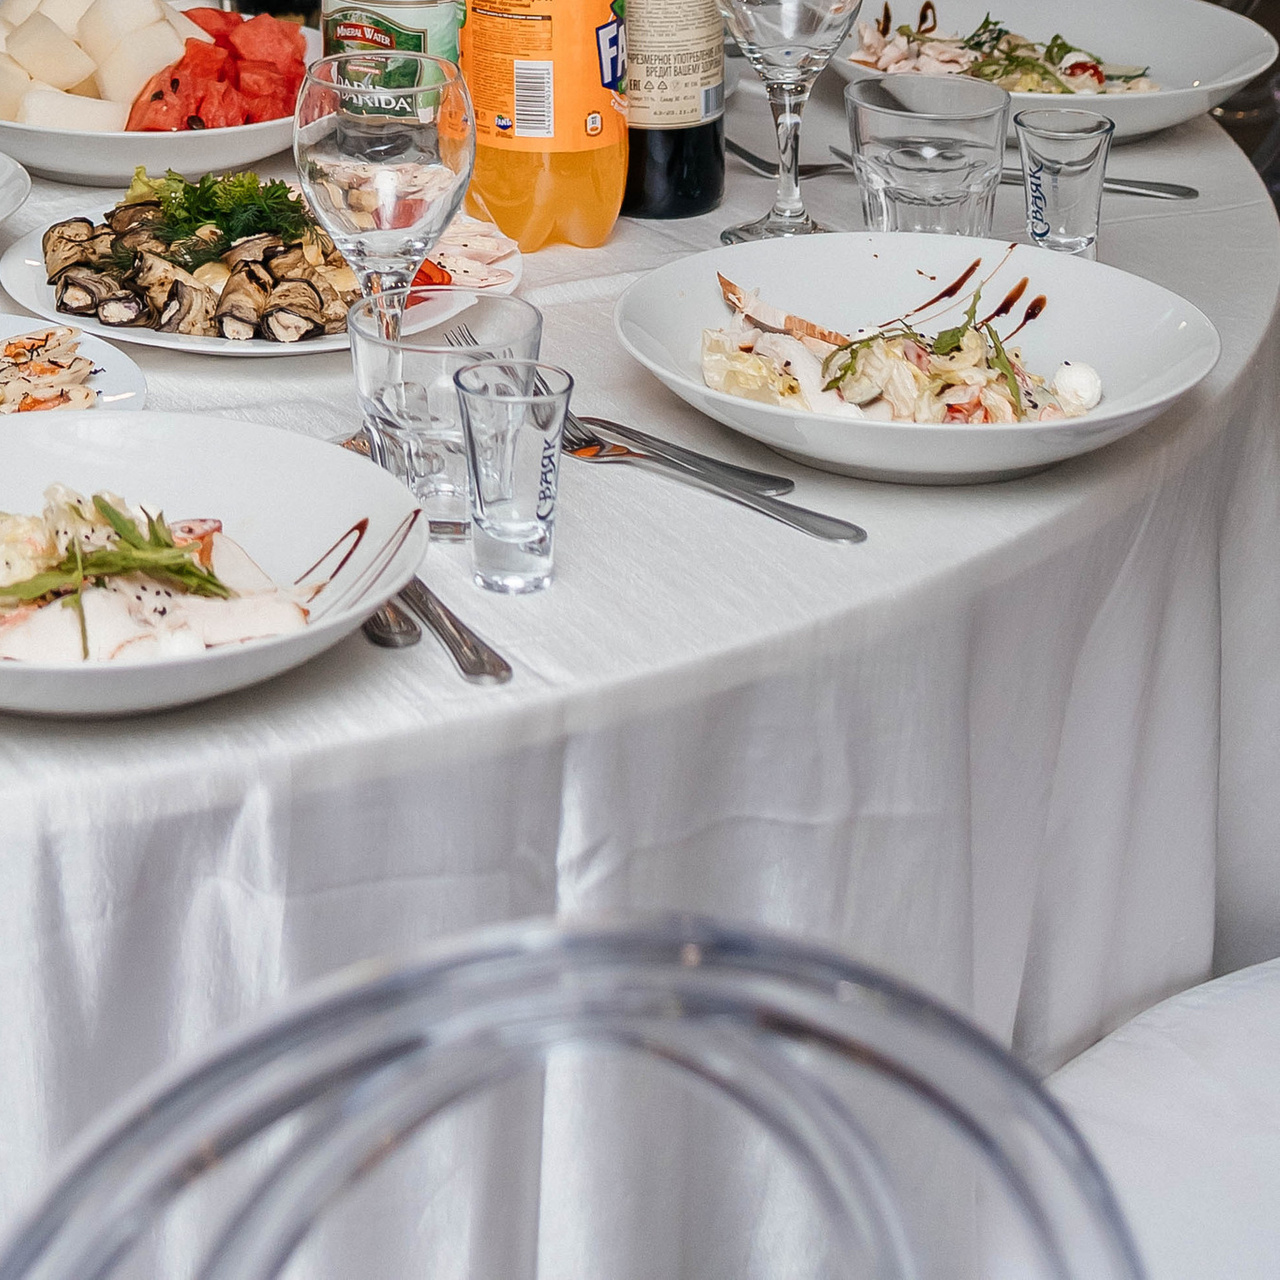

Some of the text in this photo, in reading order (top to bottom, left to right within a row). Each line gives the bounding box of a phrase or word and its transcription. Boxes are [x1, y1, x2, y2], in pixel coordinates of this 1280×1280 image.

[336, 25, 391, 47] MINERAL WATER
[627, 52, 672, 66] ЧРЕЗМЕРНОЕ
[645, 65, 672, 79] ВРЕДИТ
[673, 64, 700, 78] ВАШЕМУ
